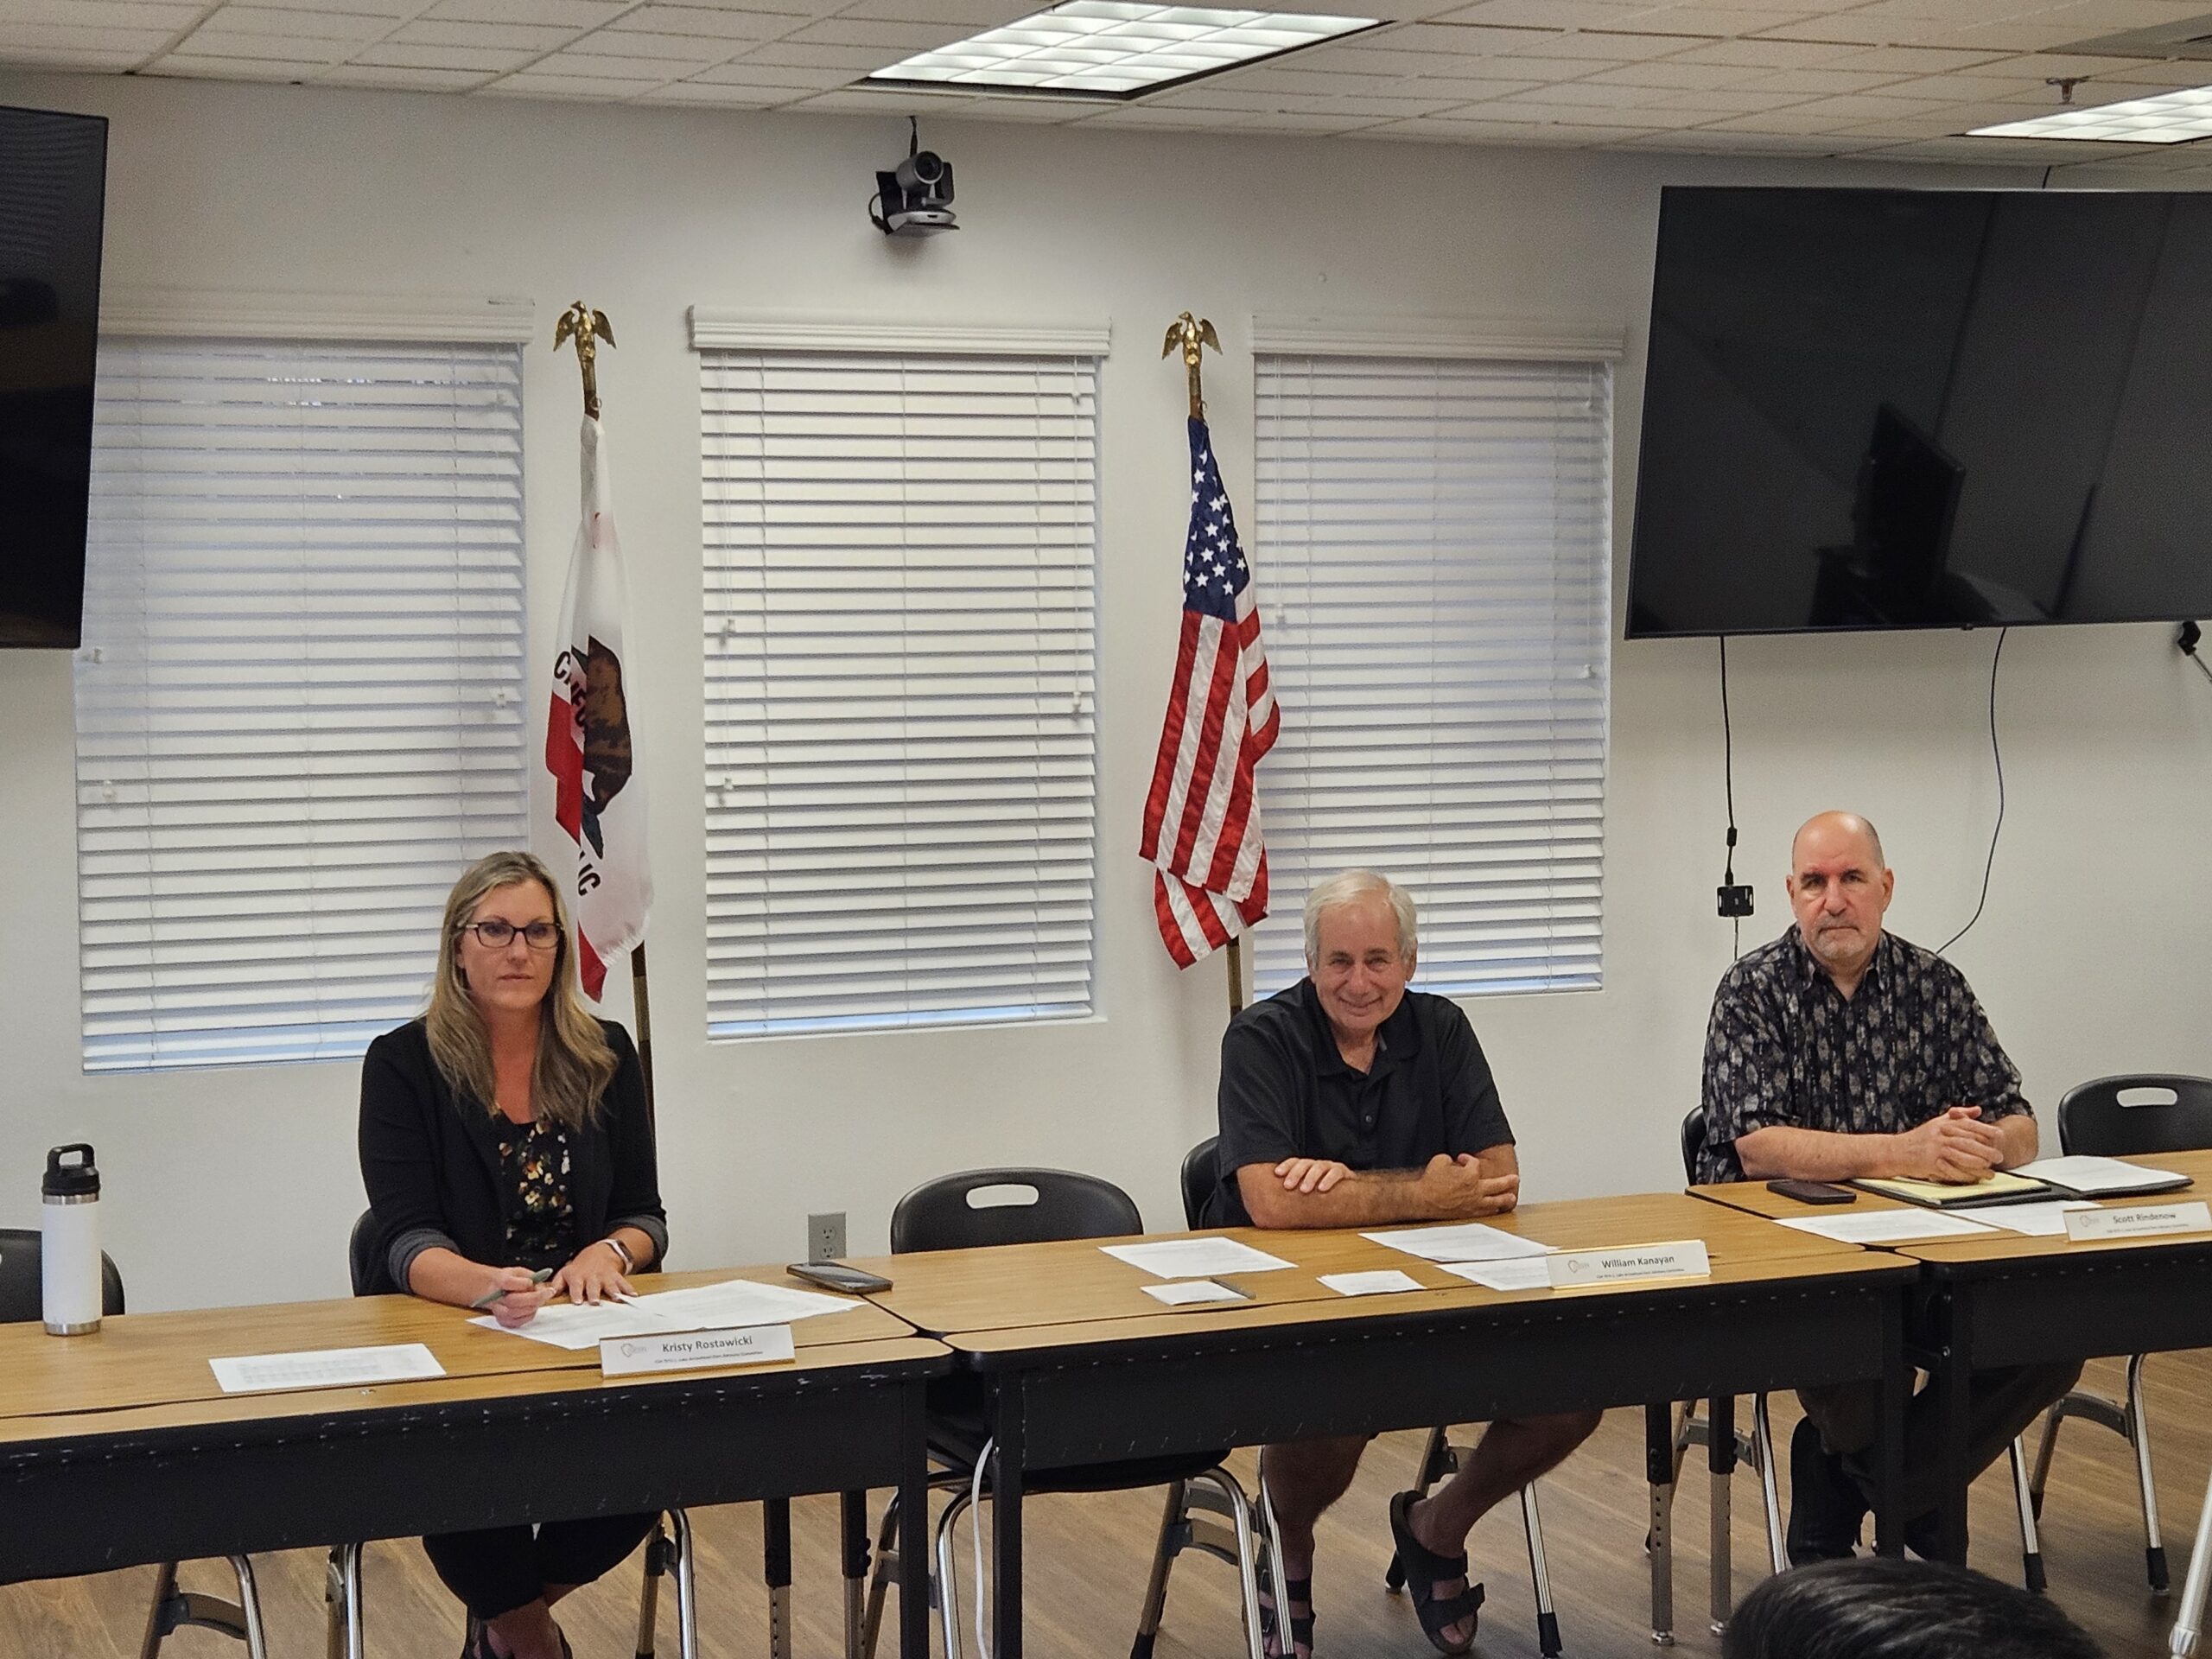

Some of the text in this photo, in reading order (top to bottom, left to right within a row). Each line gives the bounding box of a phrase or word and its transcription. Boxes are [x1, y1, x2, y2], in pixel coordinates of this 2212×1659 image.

[2113, 1216, 2134, 1224] Scott
[1601, 1258, 1636, 1268] William
[1637, 1255, 1675, 1266] Kanayan
[662, 1336, 753, 1353] Kristy Rostawicki
